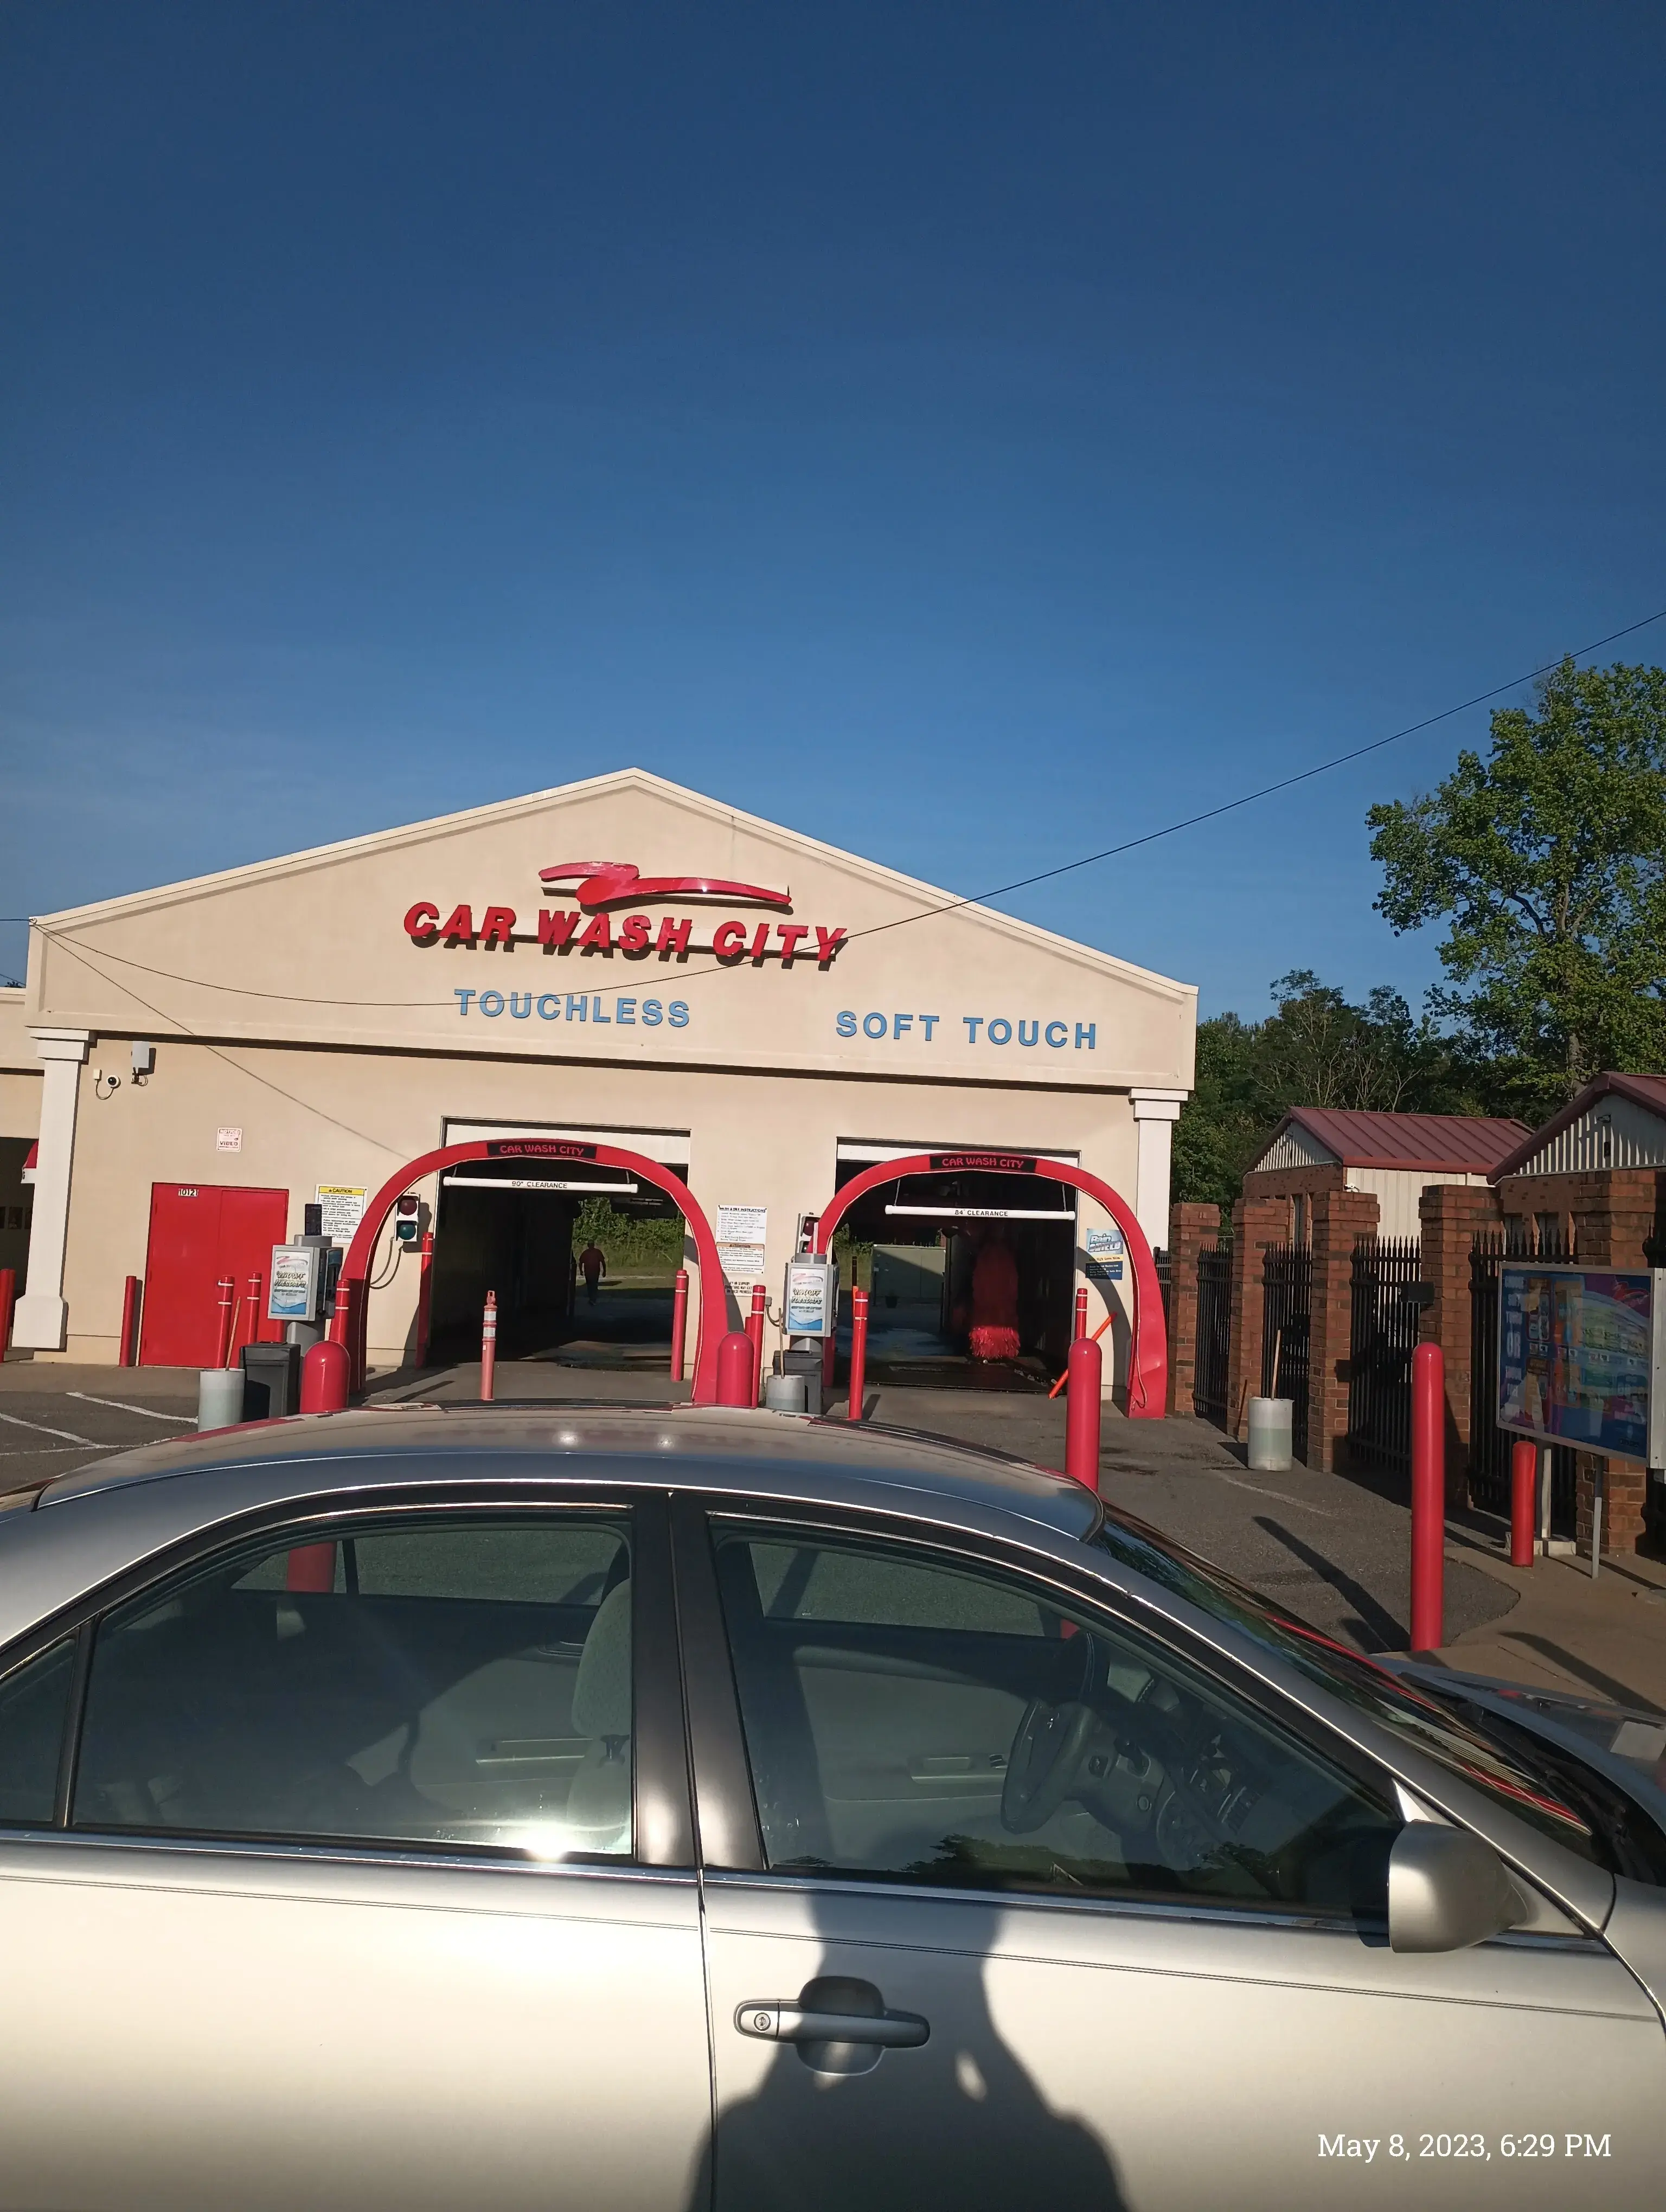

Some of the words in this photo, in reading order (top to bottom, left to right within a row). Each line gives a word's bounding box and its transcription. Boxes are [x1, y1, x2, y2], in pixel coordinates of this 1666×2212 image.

[403, 902, 516, 942] CAR
[537, 910, 693, 953] WASH
[712, 921, 847, 962] CITY
[454, 989, 690, 1027] TOUCHLESS
[836, 1011, 940, 1041] SOFT
[963, 1017, 1097, 1049] TOUCH
[499, 1144, 522, 1154] CAR
[524, 1144, 556, 1153] WASH
[559, 1146, 584, 1156] CITY
[941, 1157, 964, 1166] CAR
[965, 1158, 997, 1166] WASH
[999, 1159, 1024, 1168] CITY
[1090, 1233, 1111, 1243] Rain
